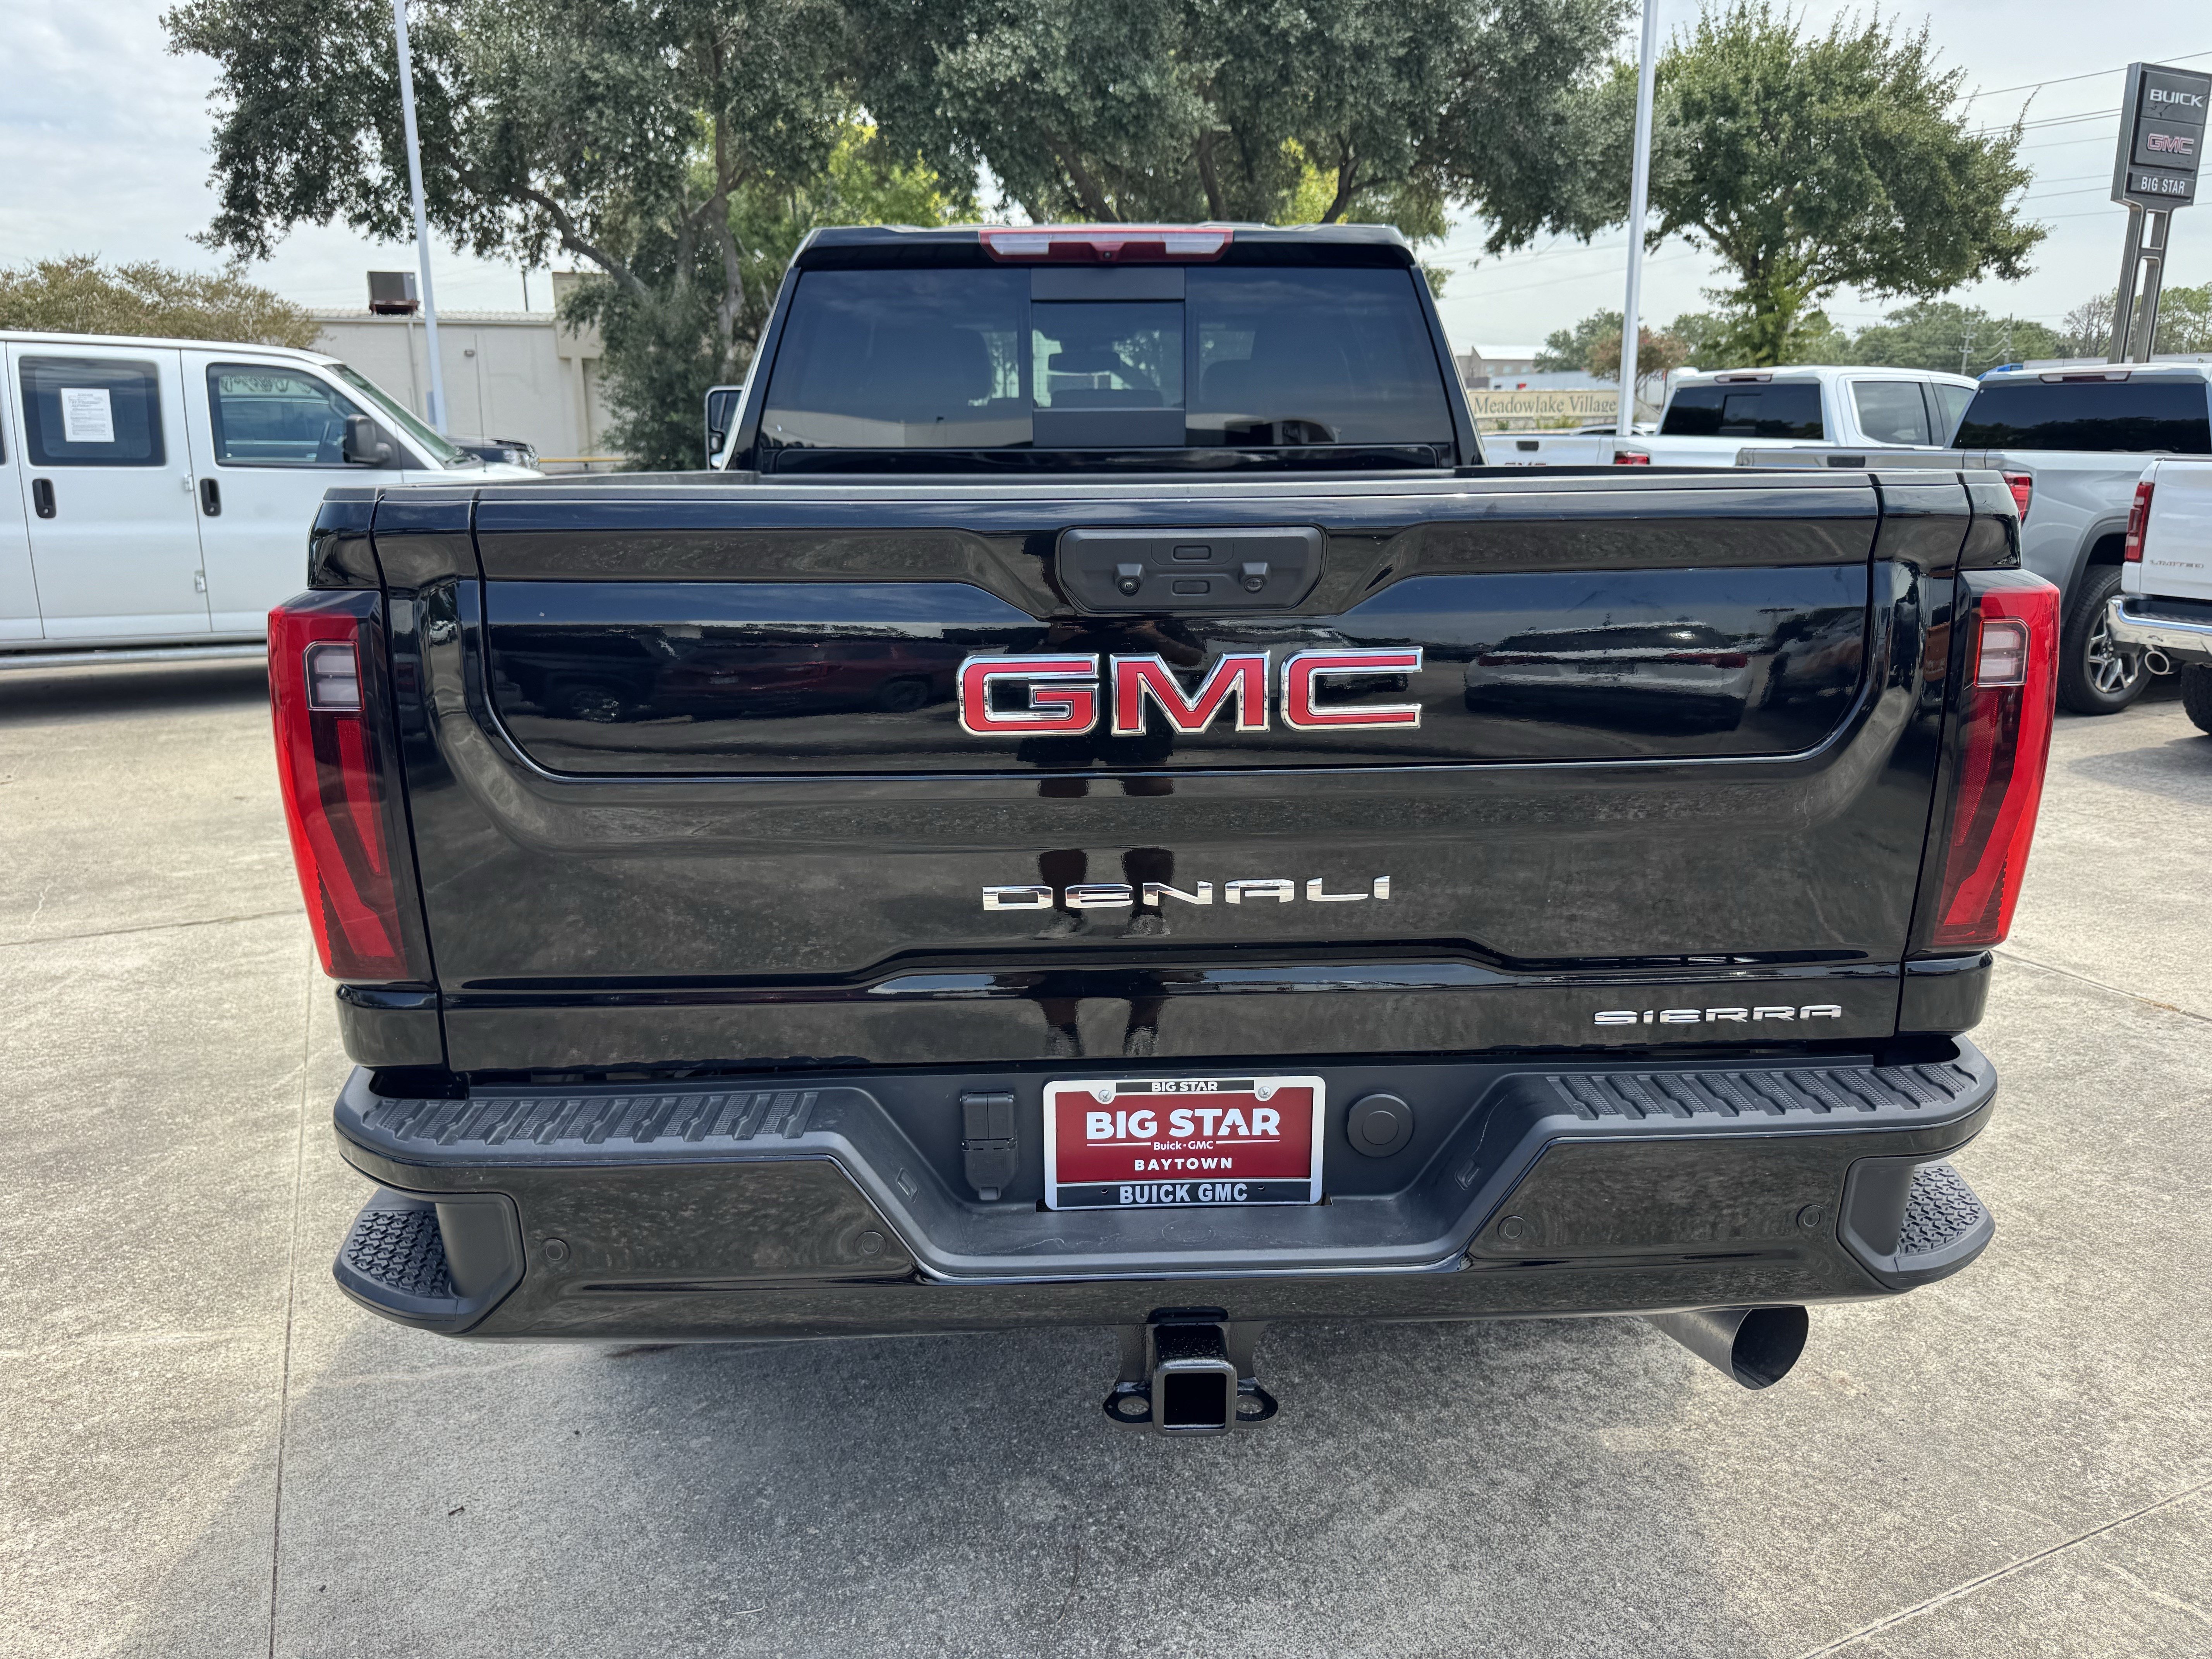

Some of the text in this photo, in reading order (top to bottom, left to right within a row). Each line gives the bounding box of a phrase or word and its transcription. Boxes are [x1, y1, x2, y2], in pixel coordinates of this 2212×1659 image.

[2149, 89, 2202, 107] BUICK
[2147, 133, 2194, 155] GMC
[2141, 176, 2185, 194] BIG STAR
[1474, 395, 1617, 414] Meadowlake Village
[957, 646, 1423, 737] GMC
[982, 875, 1390, 911] DENALI
[1594, 1005, 1842, 1025] SIERRA
[1151, 1081, 1218, 1092] BIG STAR
[1086, 1108, 1280, 1140] BIG STAR
[1135, 1157, 1232, 1171] BAYTOWN
[1120, 1183, 1248, 1204] BUICK GMC
